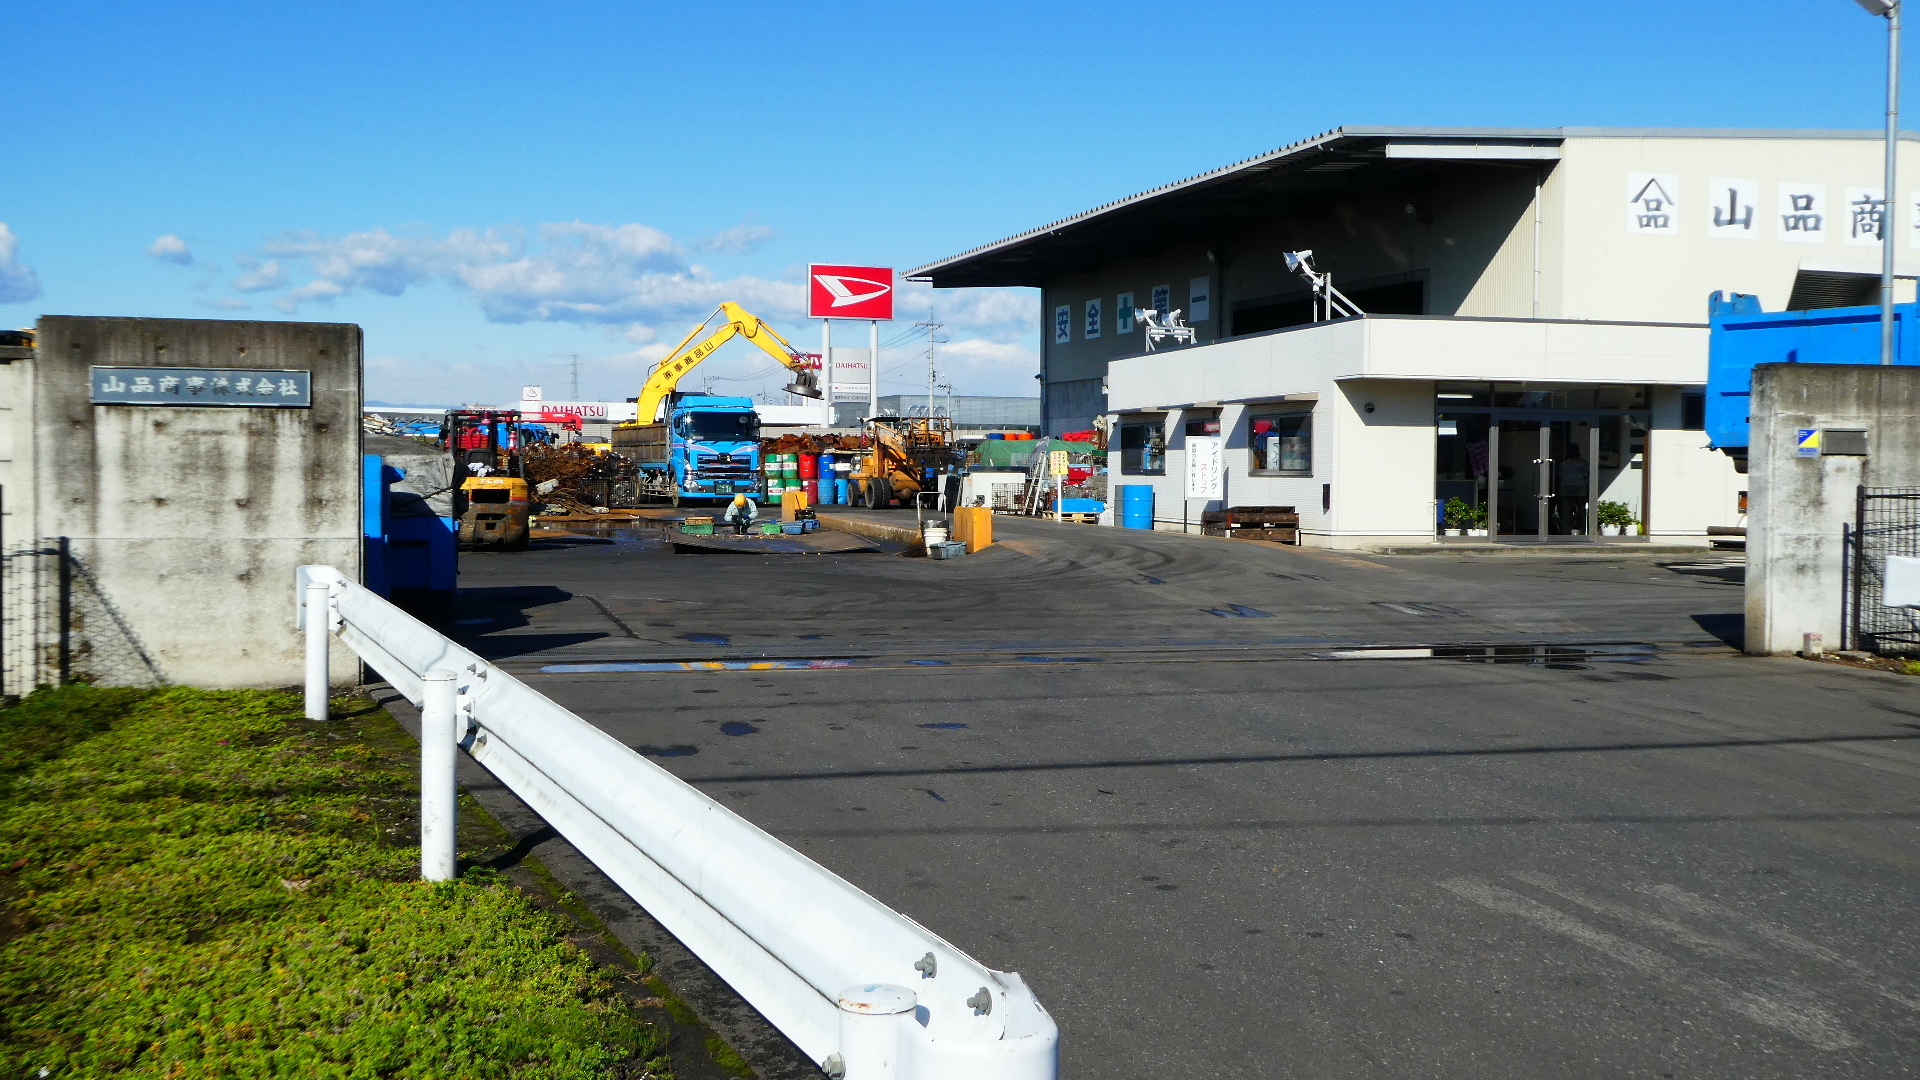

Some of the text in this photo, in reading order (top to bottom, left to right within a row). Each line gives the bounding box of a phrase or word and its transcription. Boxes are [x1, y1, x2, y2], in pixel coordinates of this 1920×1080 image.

[1713, 187, 1920, 241] 山品商
[102, 375, 299, 397] 山品商事株式会社
[541, 405, 604, 417] DAIHATSU
